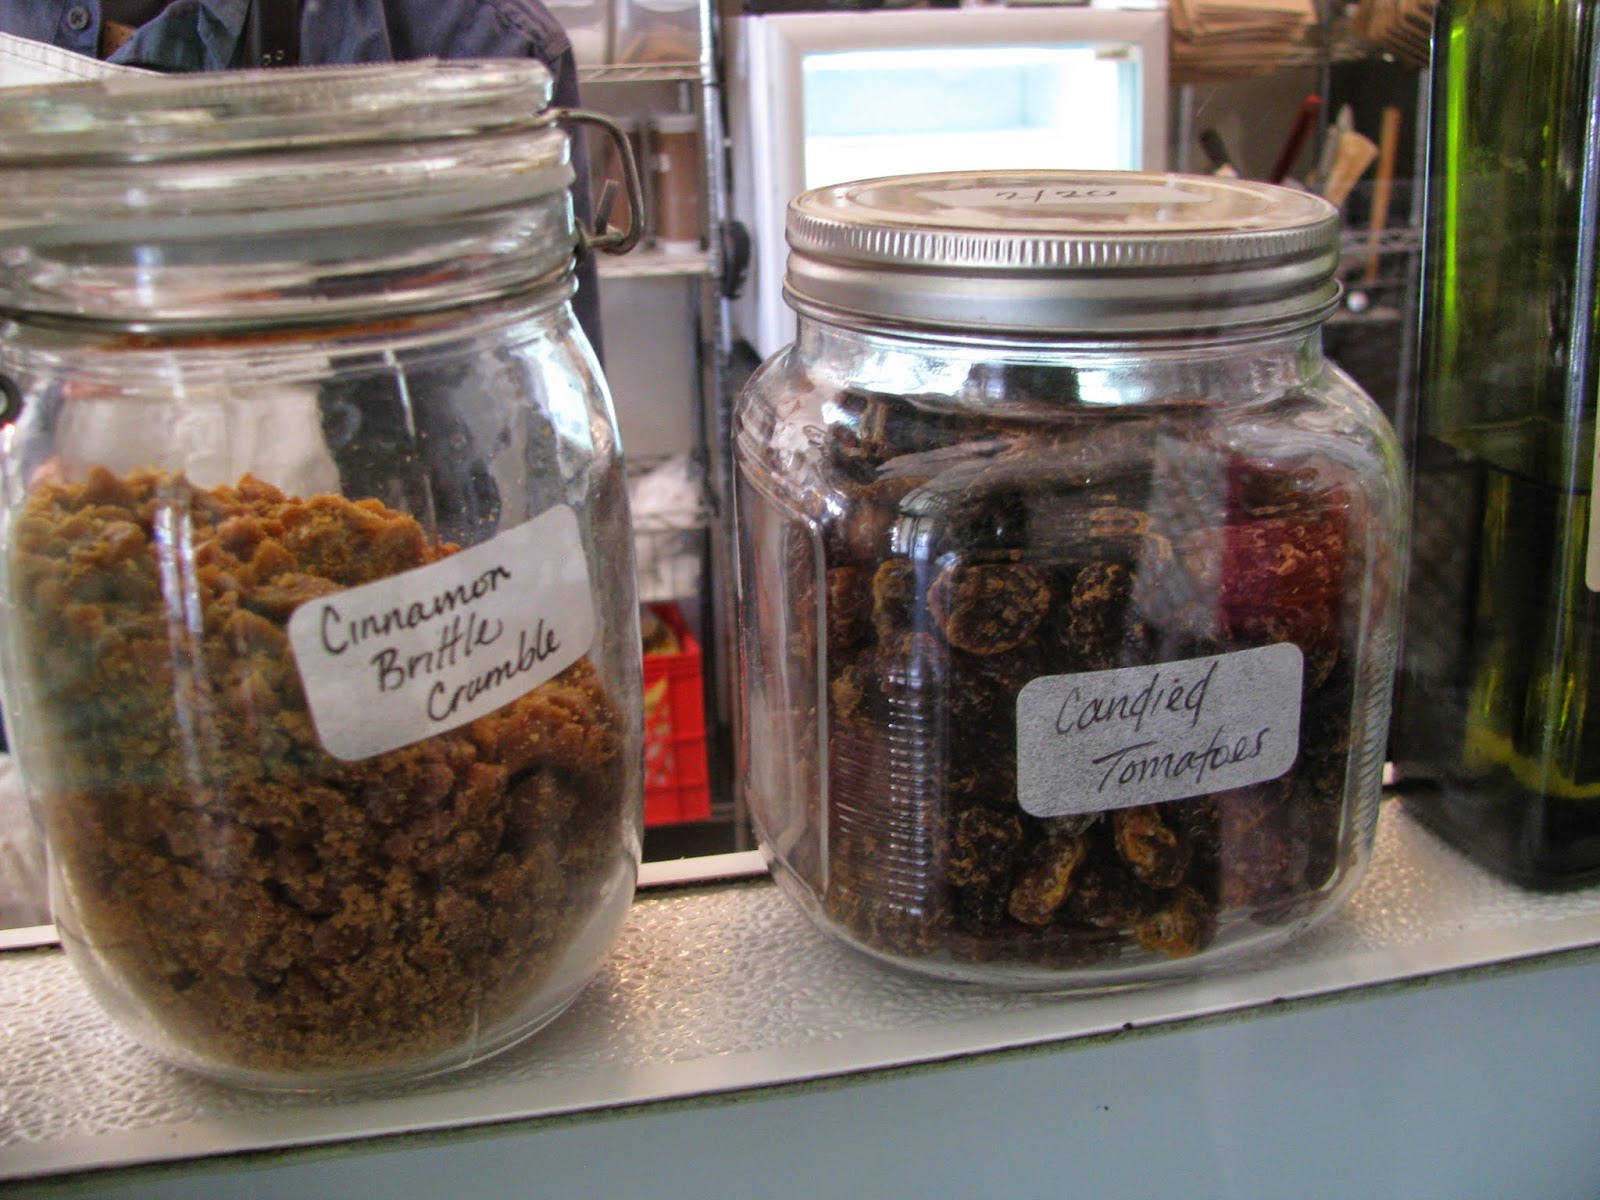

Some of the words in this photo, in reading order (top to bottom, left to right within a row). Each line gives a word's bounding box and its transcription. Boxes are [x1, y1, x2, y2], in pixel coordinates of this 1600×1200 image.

[321, 564, 512, 655] Cinnamon
[370, 612, 503, 692] Brittle
[427, 618, 561, 721] Crumble
[1056, 660, 1219, 735] Candied
[1092, 724, 1271, 793] Tomatoes
